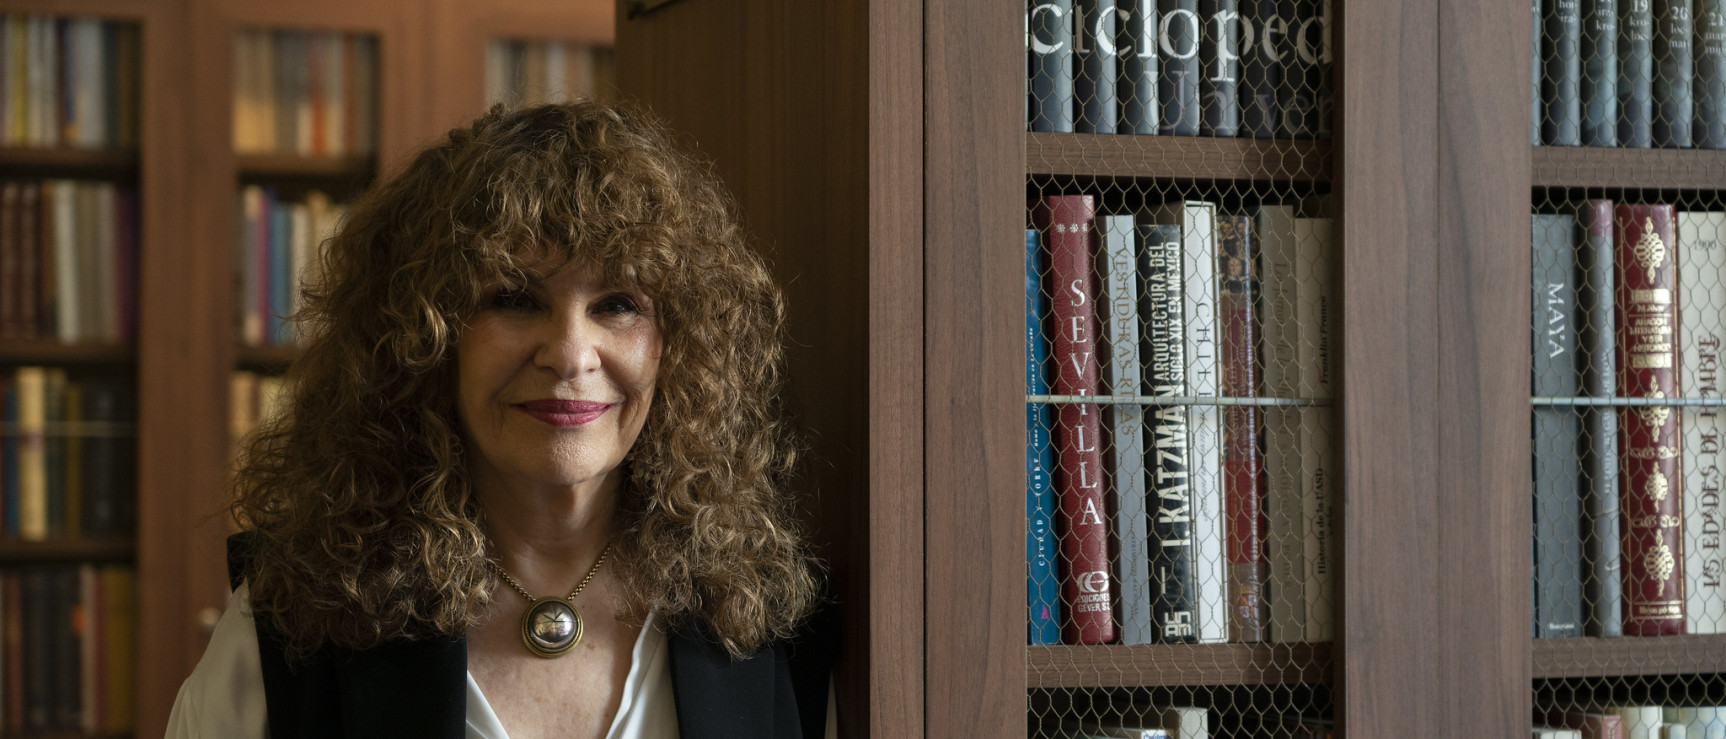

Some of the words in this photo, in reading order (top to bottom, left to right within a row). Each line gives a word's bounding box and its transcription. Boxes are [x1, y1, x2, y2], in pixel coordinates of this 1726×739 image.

[1633, 0, 1648, 13] 19
[1671, 6, 1689, 20] 20
[1708, 13, 1724, 27] 21
[1026, 0, 1334, 81] cicloped
[1149, 241, 1165, 267] DEL
[1114, 248, 1134, 369] VESTIDURAS
[1167, 296, 1182, 313] EN
[1319, 296, 1328, 334] Franco
[1548, 282, 1566, 359] MAYA
[1150, 272, 1170, 381] ARQUITECTURA
[1168, 318, 1183, 338] XIX
[1169, 344, 1185, 382] SIGLO
[1069, 278, 1103, 526] SEVILLA
[1120, 376, 1136, 436] RIAS
[1154, 384, 1191, 523] KATZMAN
[1316, 515, 1325, 528] de
[1036, 519, 1046, 567] CIUDAD
[1130, 533, 1138, 577] ATRIMONIO
[1317, 531, 1327, 575] Historia
[1077, 592, 1111, 604] EDICIONES
